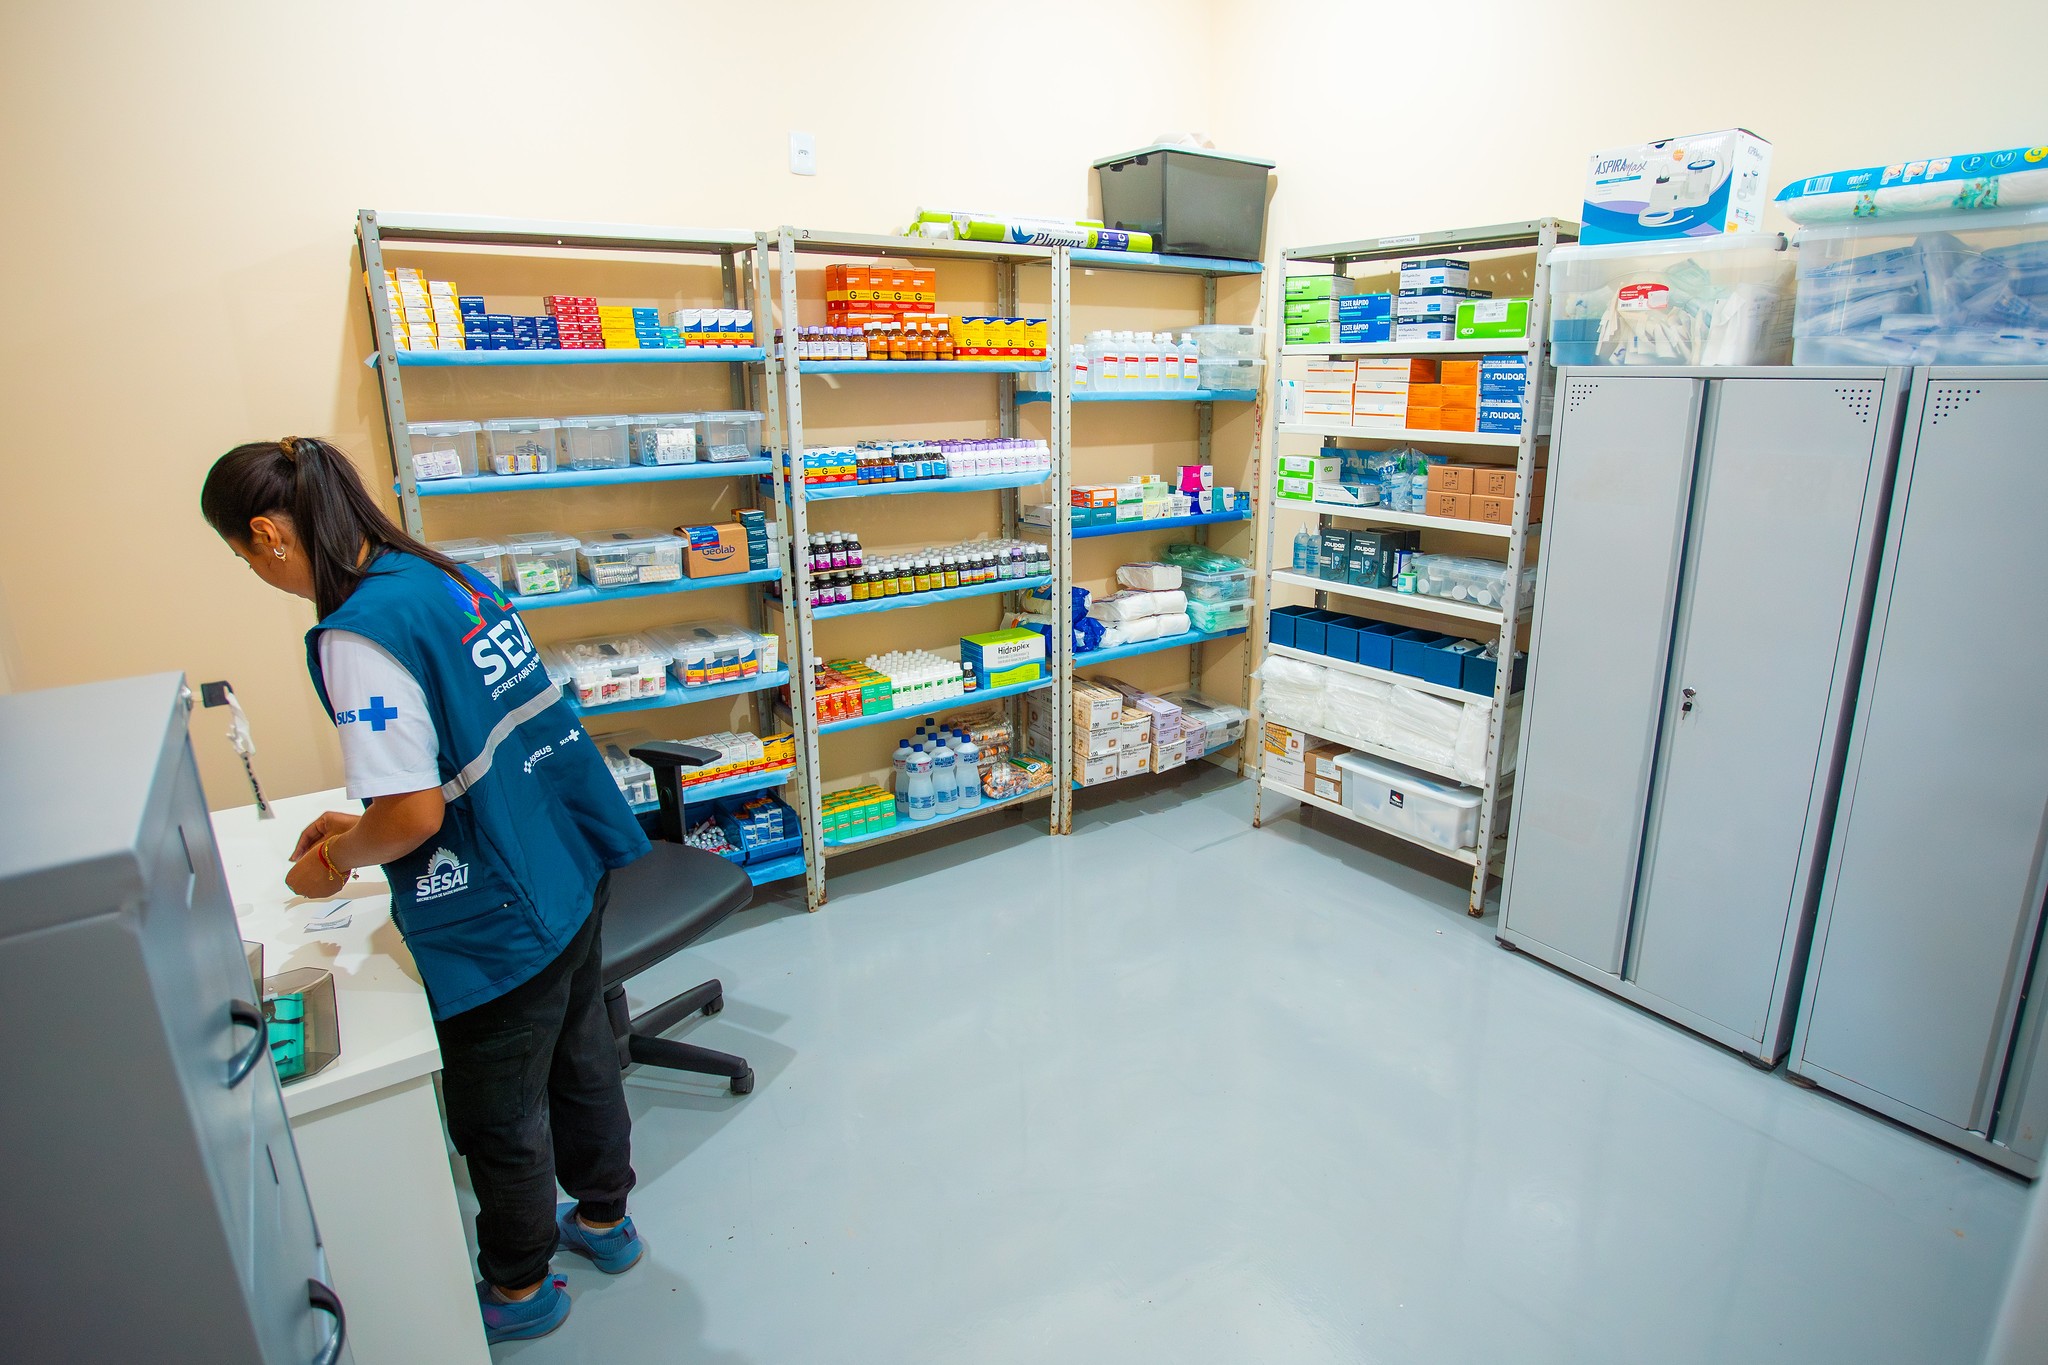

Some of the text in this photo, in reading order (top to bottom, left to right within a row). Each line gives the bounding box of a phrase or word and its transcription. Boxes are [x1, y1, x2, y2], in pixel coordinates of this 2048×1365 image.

[849, 291, 857, 299] G
[873, 291, 880, 300] G
[894, 292, 901, 300] G
[915, 293, 922, 301] G
[965, 338, 971, 346] G
[1489, 411, 1520, 419] SOLIDOR
[822, 467, 828, 475] G
[702, 545, 735, 556] Geolab
[997, 643, 1030, 654] Hidraplex
[337, 710, 357, 725] SUS
[416, 866, 469, 897] SESAI
